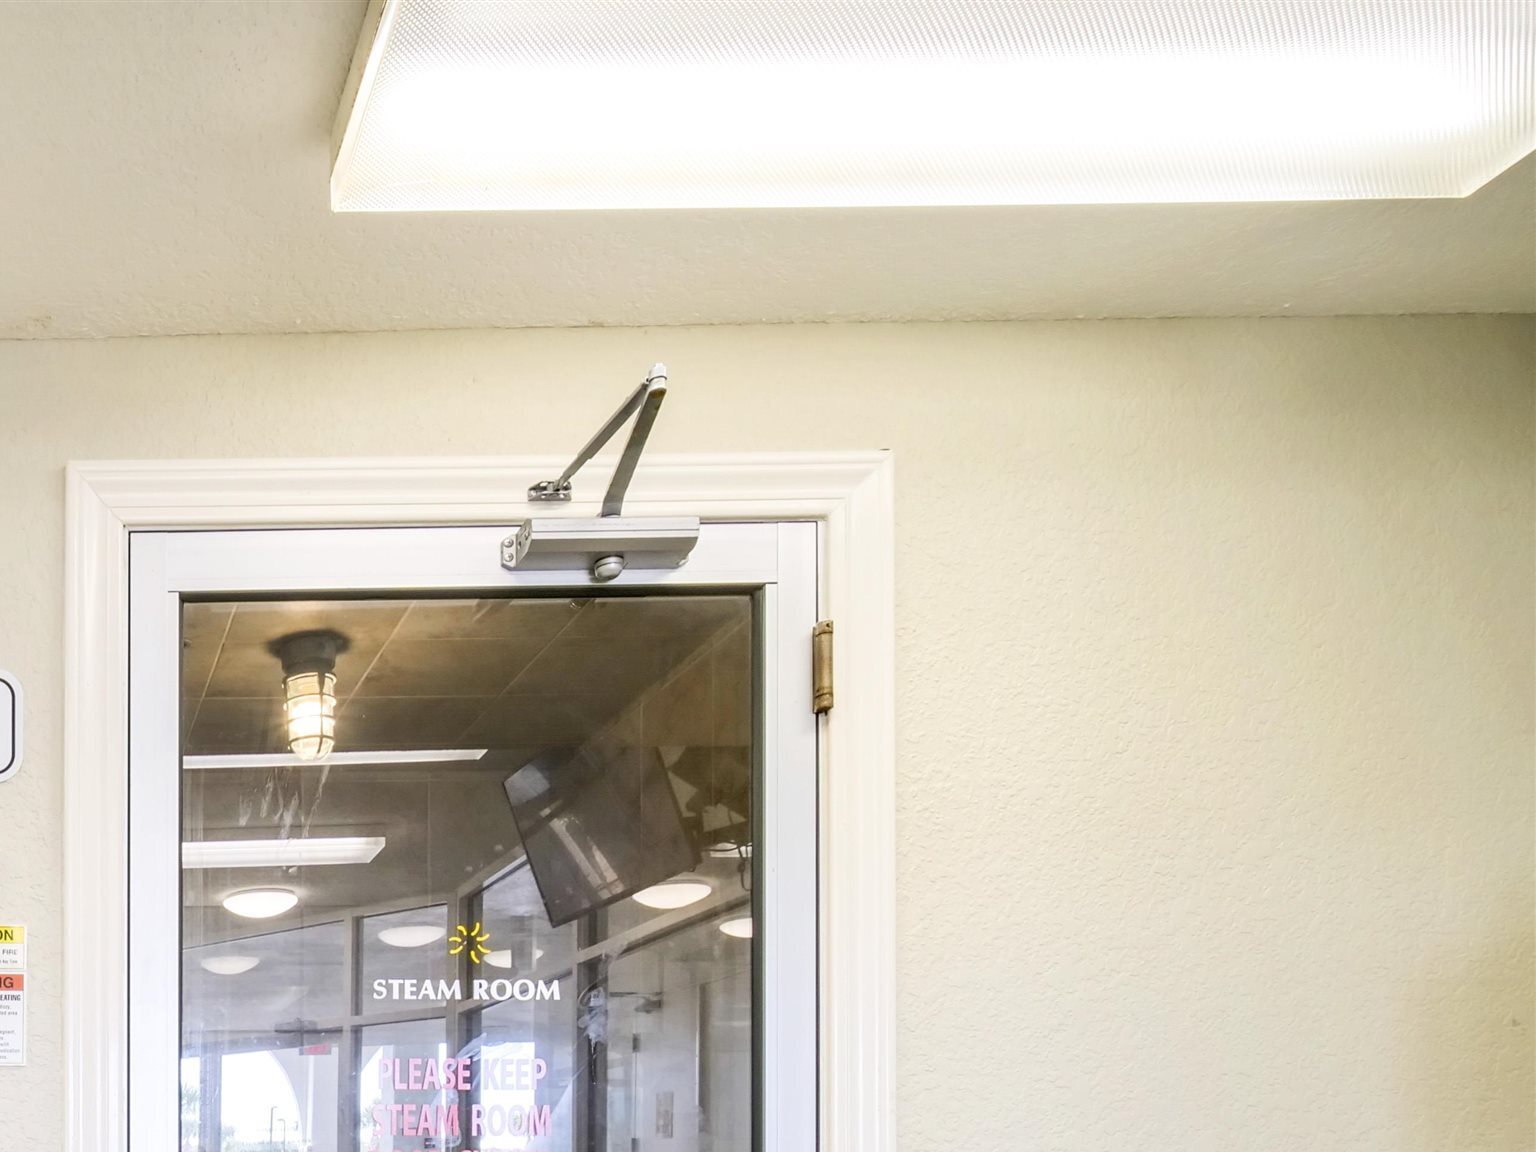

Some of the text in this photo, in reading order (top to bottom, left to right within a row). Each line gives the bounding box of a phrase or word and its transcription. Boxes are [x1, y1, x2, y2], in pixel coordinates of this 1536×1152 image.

[373, 979, 560, 1000] STEAM ROOM
[378, 1058, 547, 1090] PLEASE KEEP
[372, 1104, 552, 1136] STEAM ROOM
